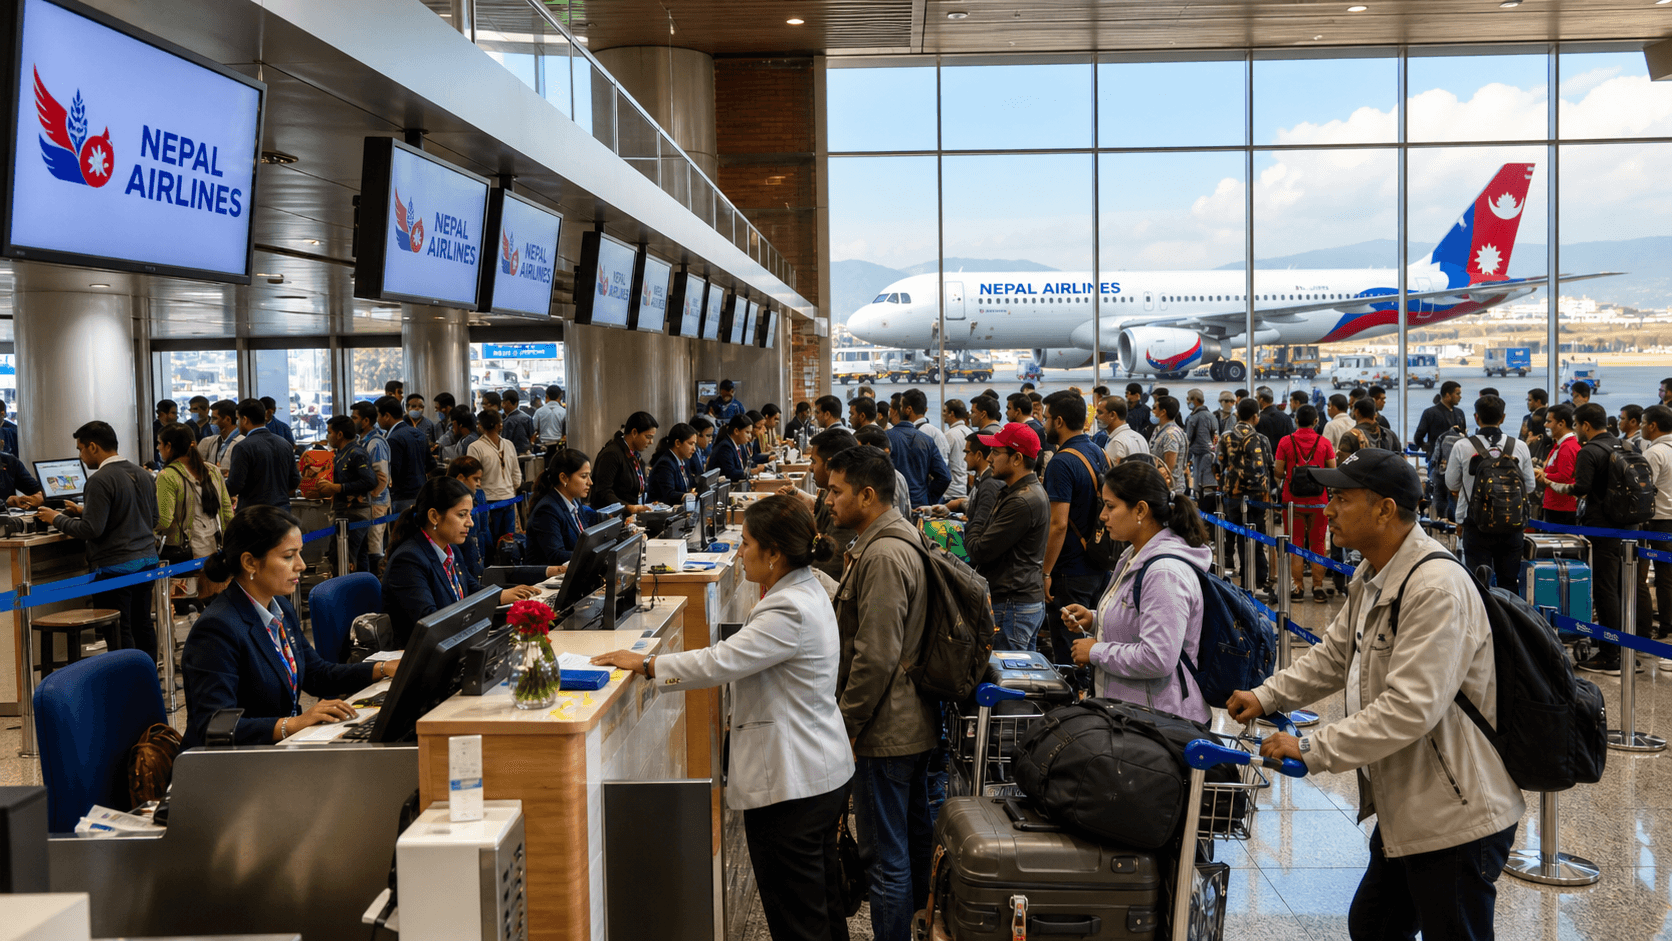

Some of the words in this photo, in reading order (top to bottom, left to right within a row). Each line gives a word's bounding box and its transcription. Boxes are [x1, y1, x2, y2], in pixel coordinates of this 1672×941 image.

[141, 124, 223, 178] NEPAL
[125, 164, 242, 217] AIRLINES
[434, 211, 469, 240] NEPAL
[427, 236, 476, 266] AIRLINES
[525, 242, 547, 264] NEPAL
[980, 283, 1038, 295] NEPAL
[1042, 282, 1121, 294] AIRLINES
